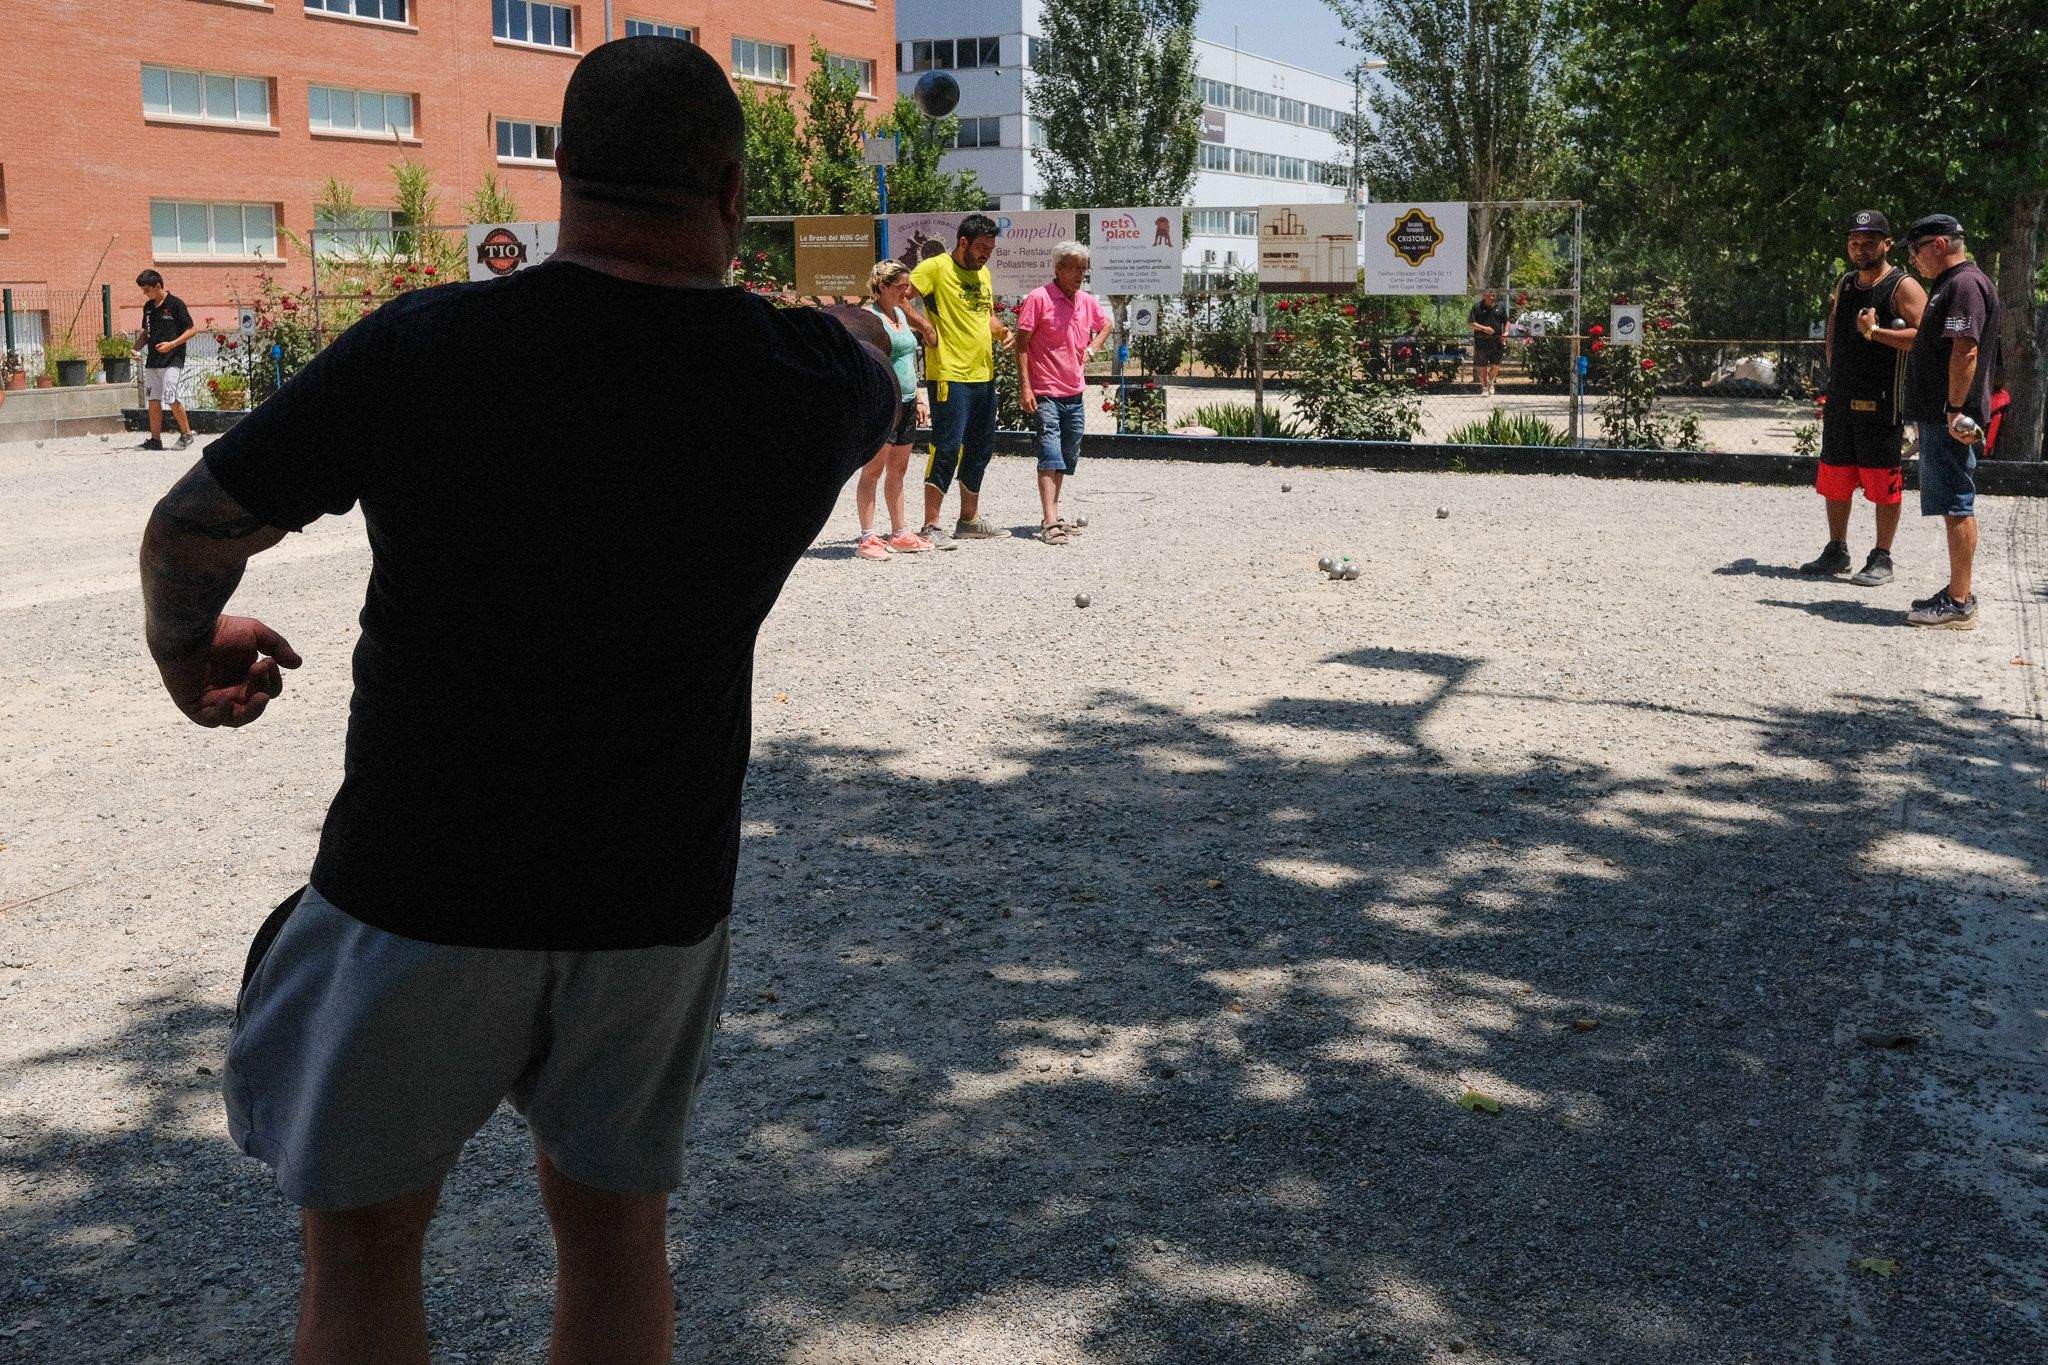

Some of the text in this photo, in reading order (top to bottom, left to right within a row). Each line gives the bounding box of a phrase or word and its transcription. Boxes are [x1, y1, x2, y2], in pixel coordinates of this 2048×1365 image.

[997, 217, 1066, 242] Pompello
[1101, 218, 1130, 232] pets
[1106, 229, 1140, 242] place
[996, 248, 1011, 256] Bar
[996, 260, 1038, 269] Pollastres
